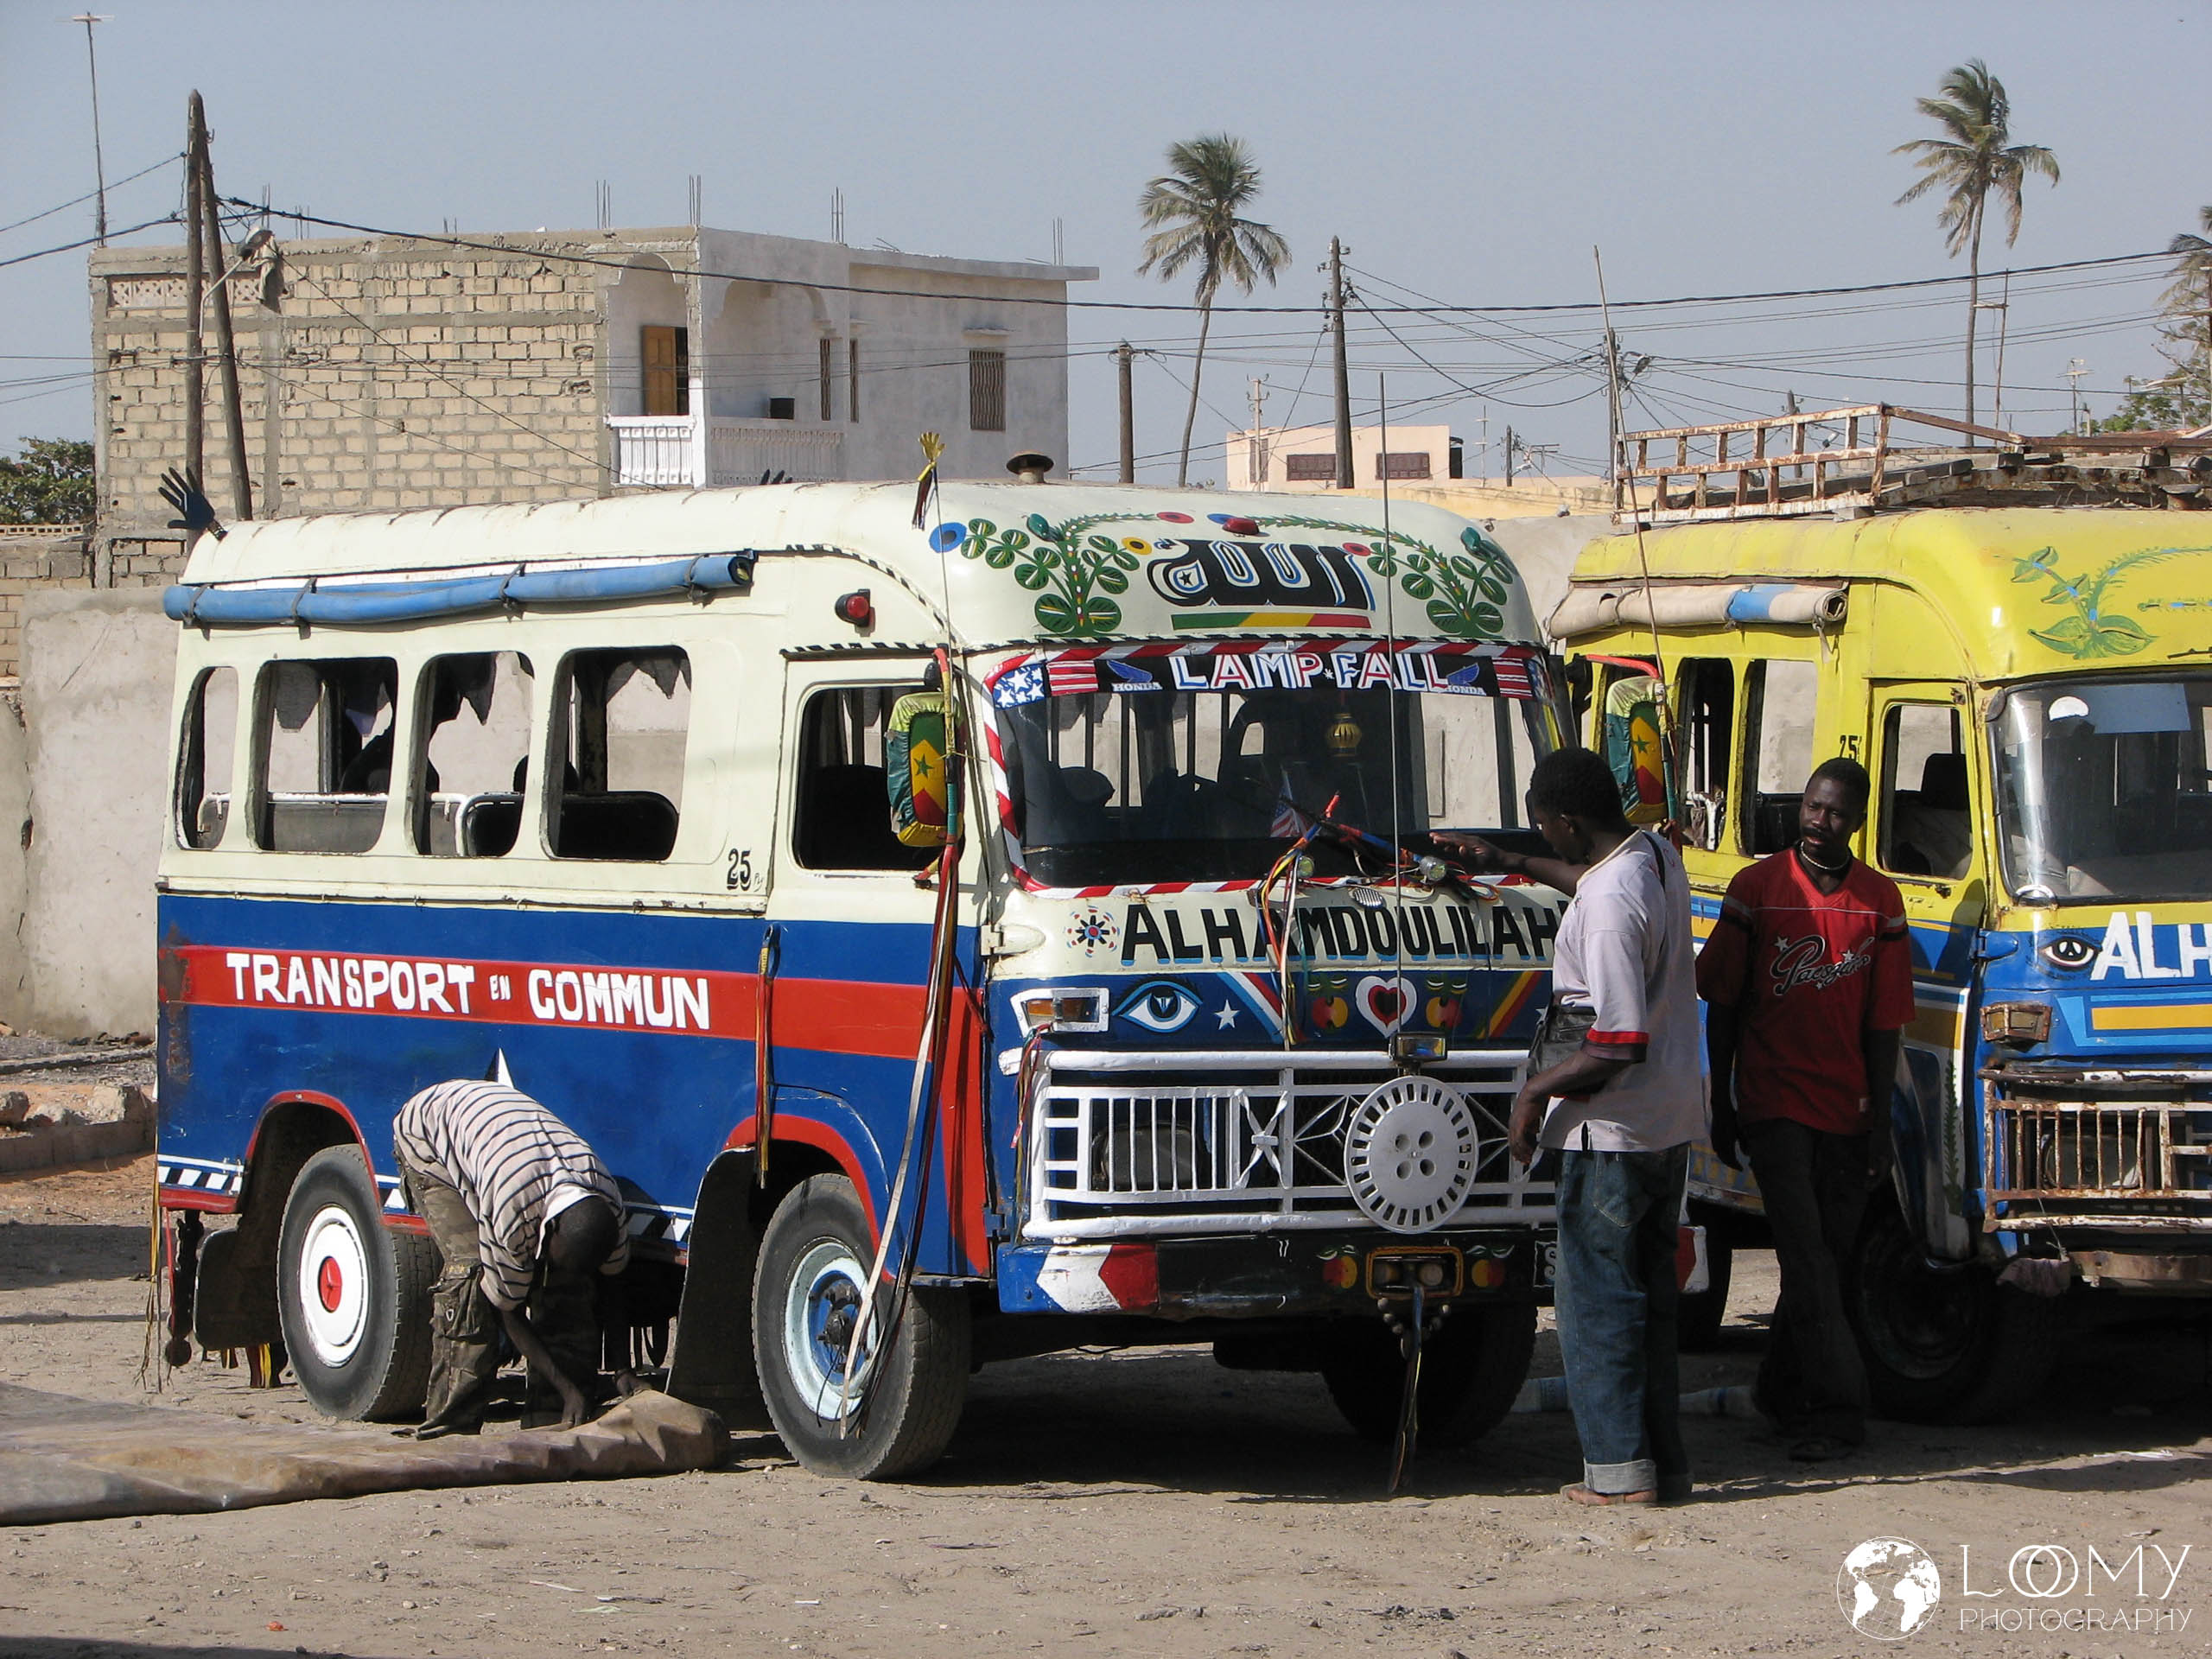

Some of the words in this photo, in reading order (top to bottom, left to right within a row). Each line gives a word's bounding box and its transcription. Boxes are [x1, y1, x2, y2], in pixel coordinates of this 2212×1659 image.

[1111, 681, 1163, 692] HONDA
[1168, 652, 1324, 690] LAMP
[1330, 652, 1449, 692] FALL
[727, 848, 751, 892] 25
[2089, 911, 2212, 981] ALH
[226, 952, 474, 1014] TRANSPORT
[528, 968, 710, 1030] COMMUN
